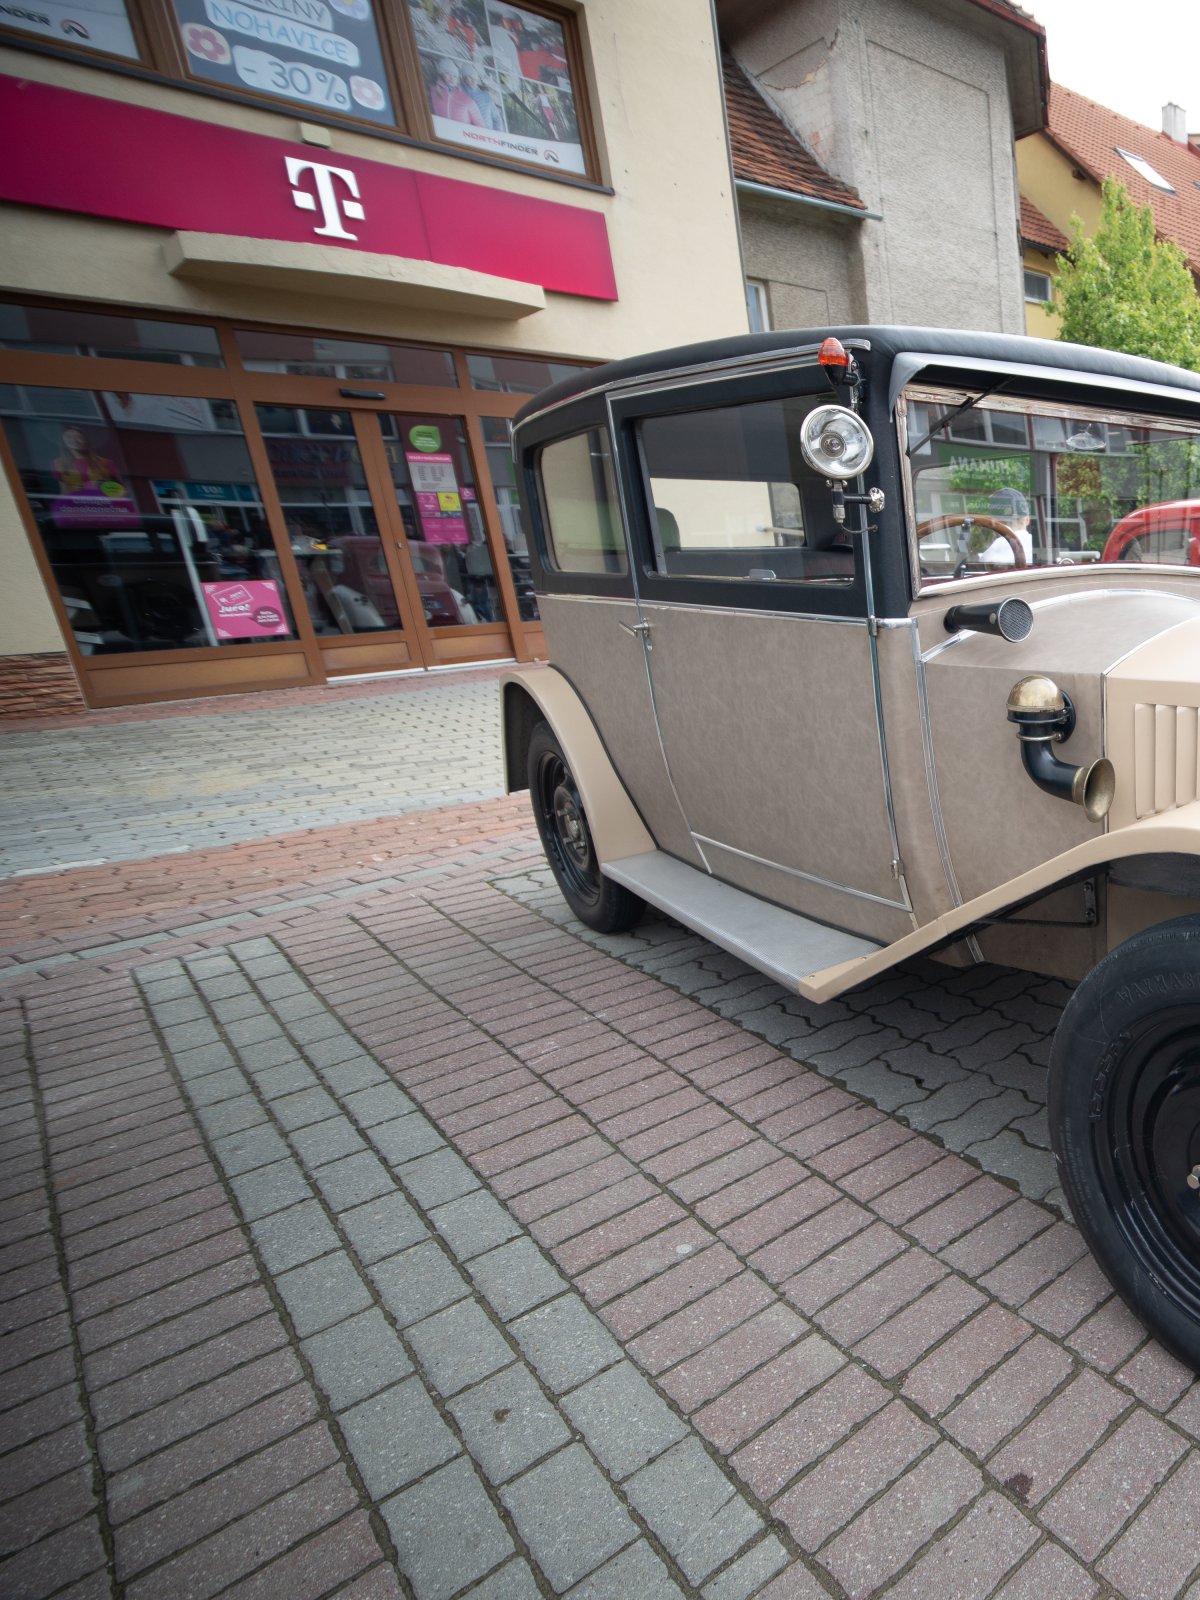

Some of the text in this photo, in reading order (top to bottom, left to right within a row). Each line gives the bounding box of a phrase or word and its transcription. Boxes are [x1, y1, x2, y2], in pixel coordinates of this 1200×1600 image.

[210, 1, 348, 62] NOHAVICE
[462, 130, 538, 156] NORTHFINDER
[284, 155, 366, 241] T
